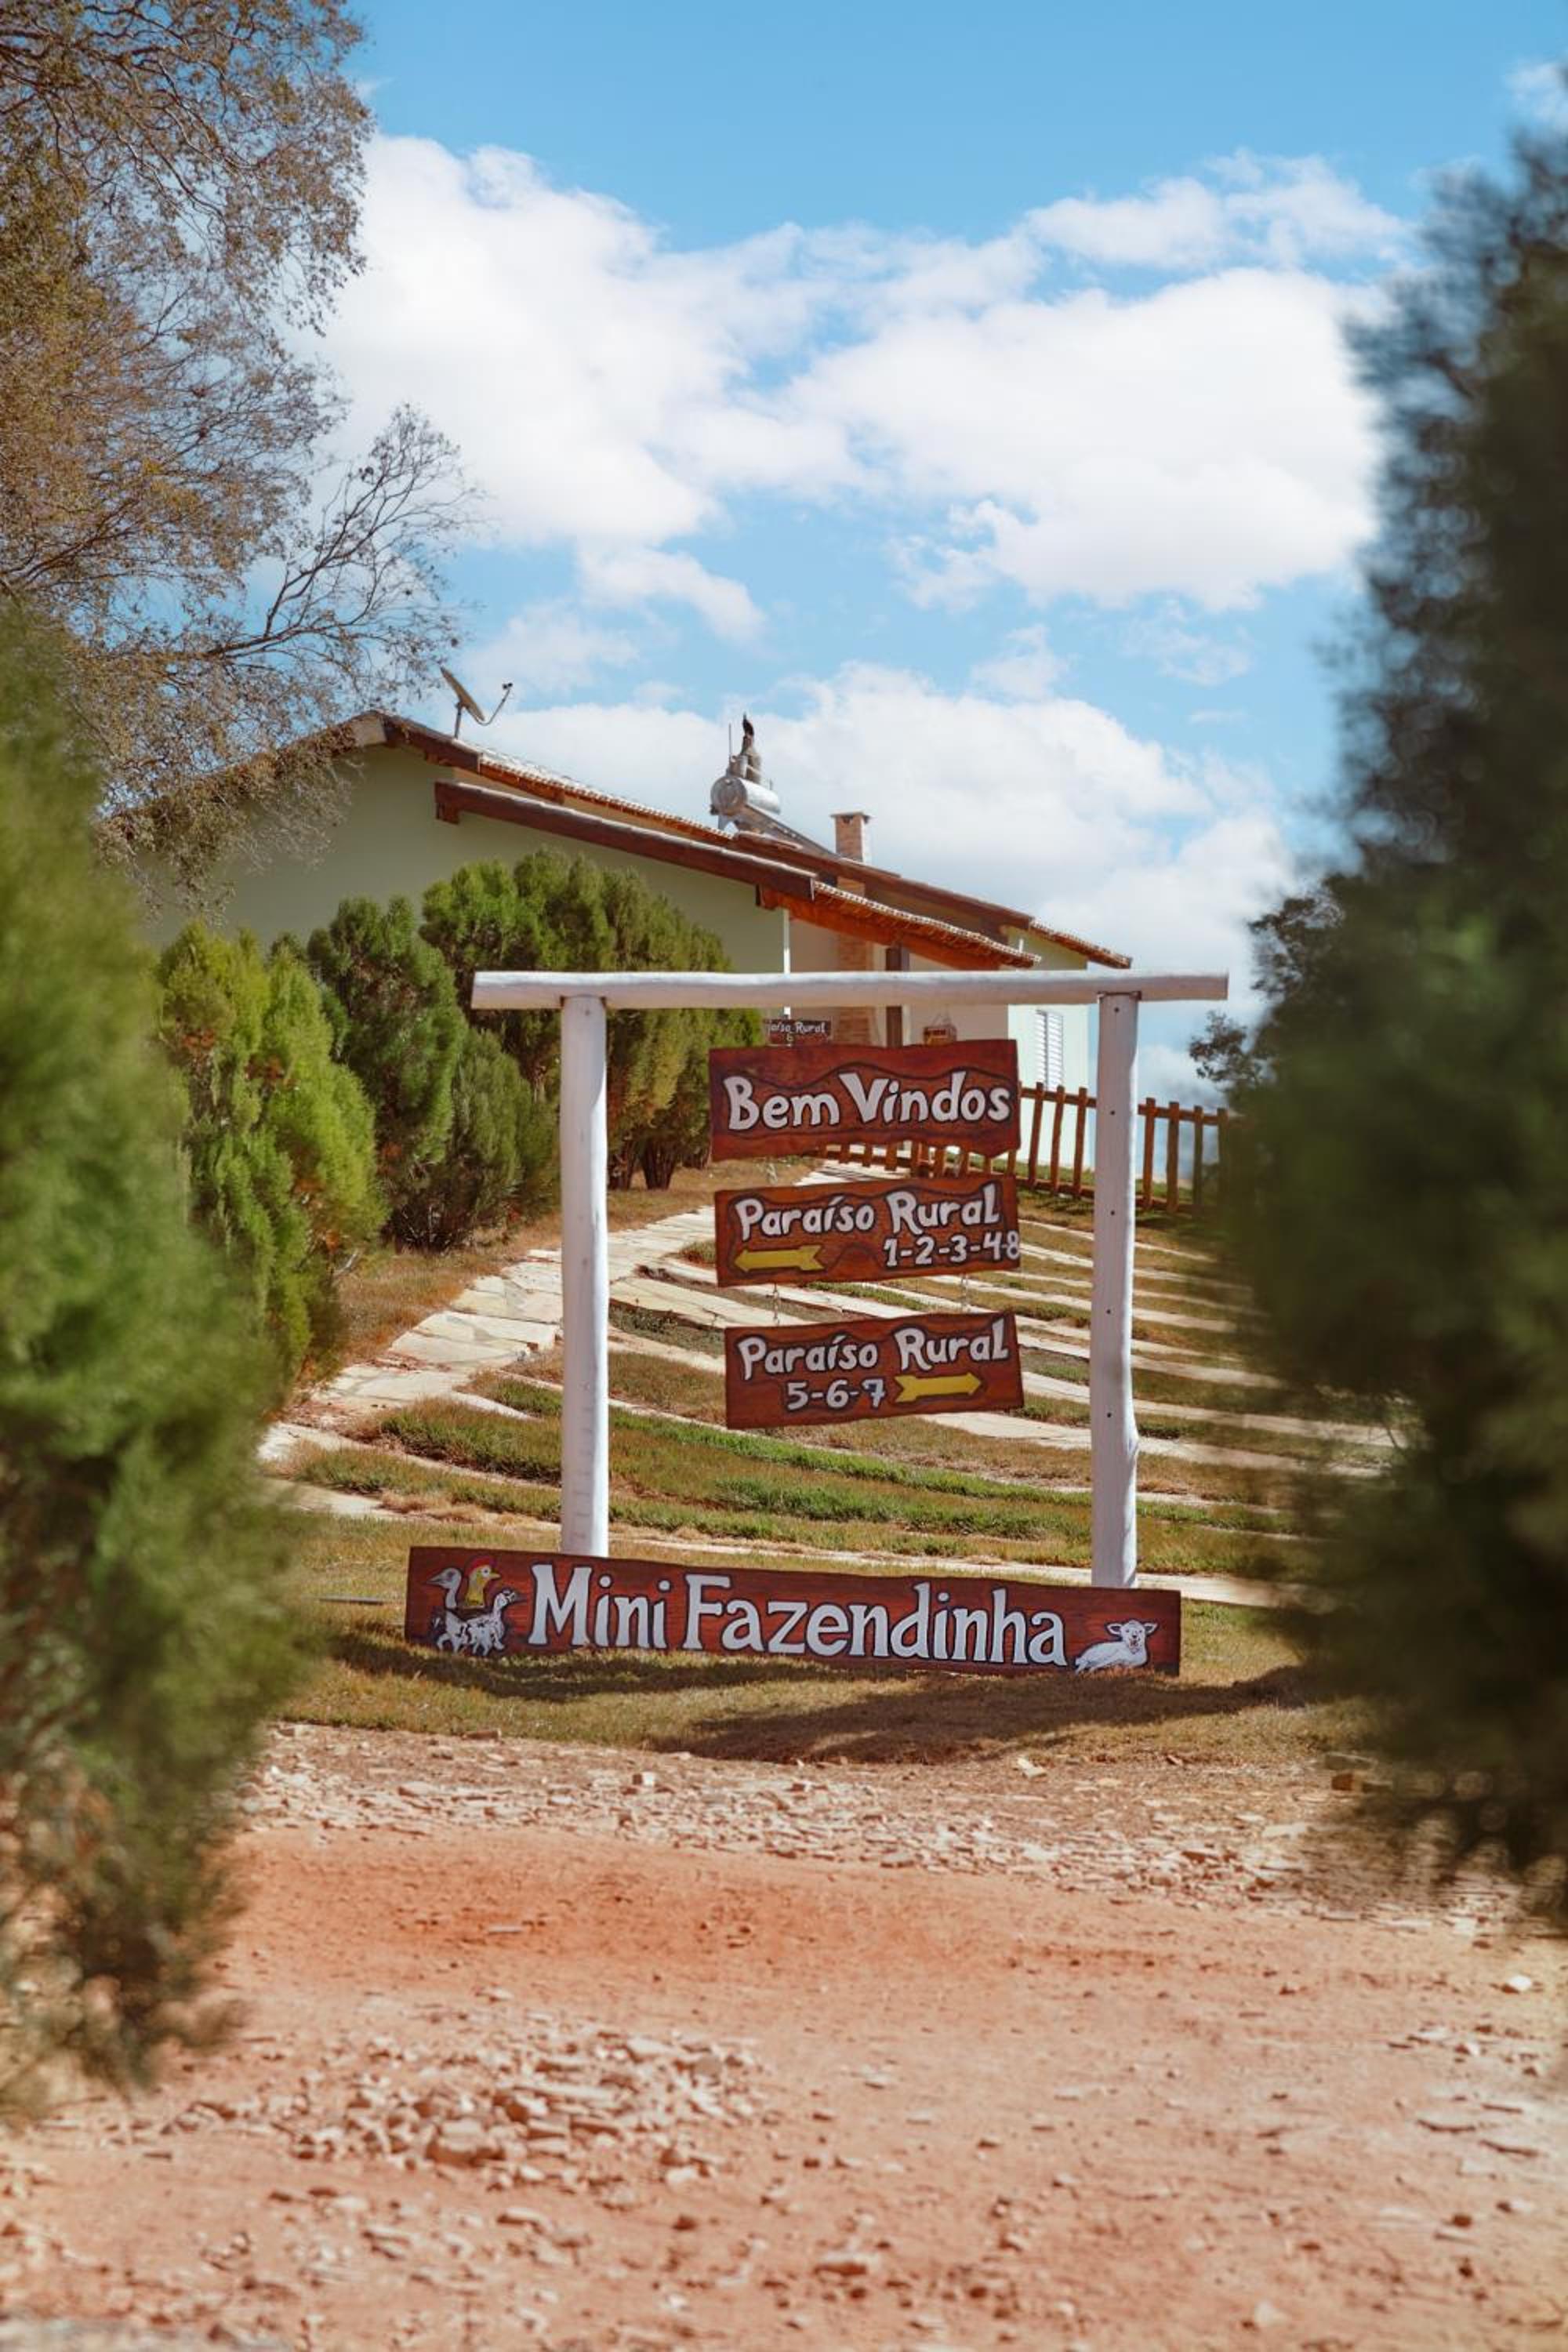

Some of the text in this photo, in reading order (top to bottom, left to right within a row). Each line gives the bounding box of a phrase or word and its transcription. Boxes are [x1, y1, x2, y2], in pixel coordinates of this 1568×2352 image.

[723, 1070, 1011, 1130] Bem Vindos
[735, 1183, 1000, 1241] Paraíso Rural
[737, 1318, 1009, 1381] Paraíso Rural
[786, 1378, 885, 1410] 5-6-7
[528, 1564, 1067, 1666] Mini Fazendinha
